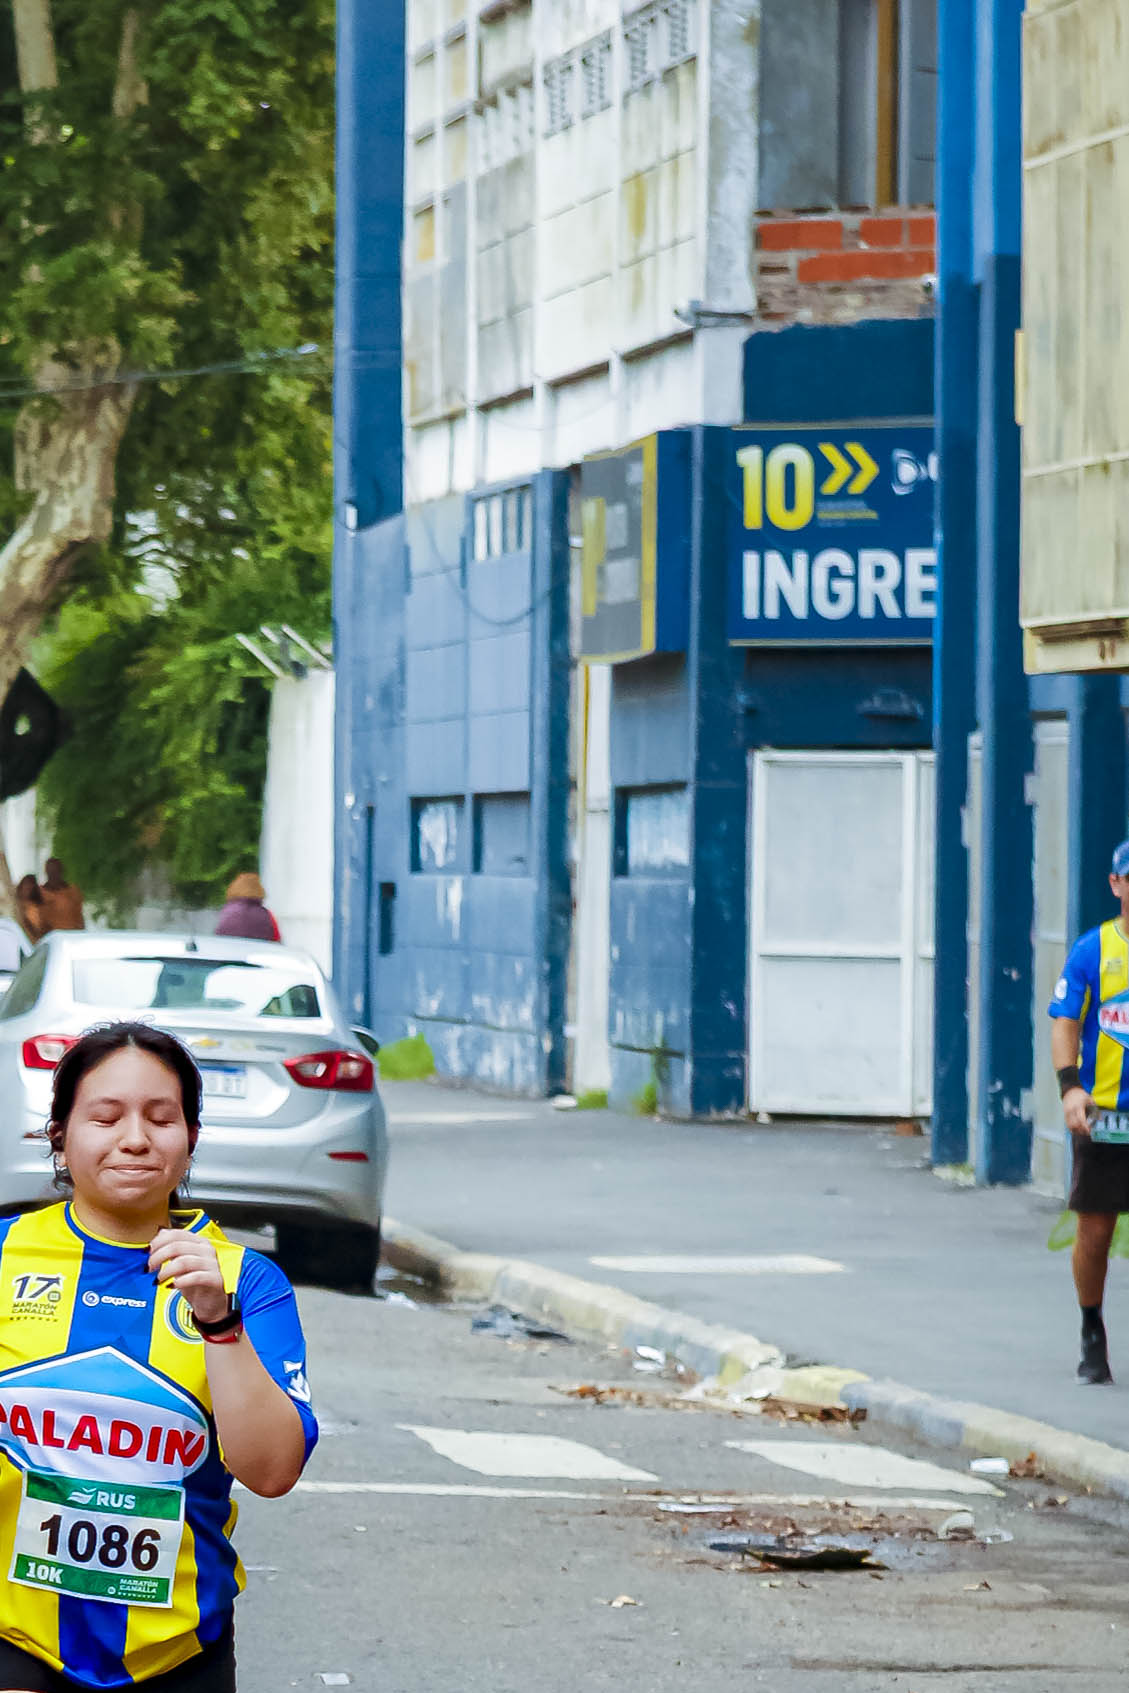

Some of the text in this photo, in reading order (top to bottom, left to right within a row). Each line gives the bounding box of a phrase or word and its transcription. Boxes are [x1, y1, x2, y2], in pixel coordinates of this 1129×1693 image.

[736, 443, 815, 531] 10
[742, 548, 936, 620] INGRE
[101, 1295, 147, 1308] express
[96, 1491, 136, 1509] RUS
[40, 1514, 161, 1571] 1086
[26, 1562, 64, 1584] 10K
